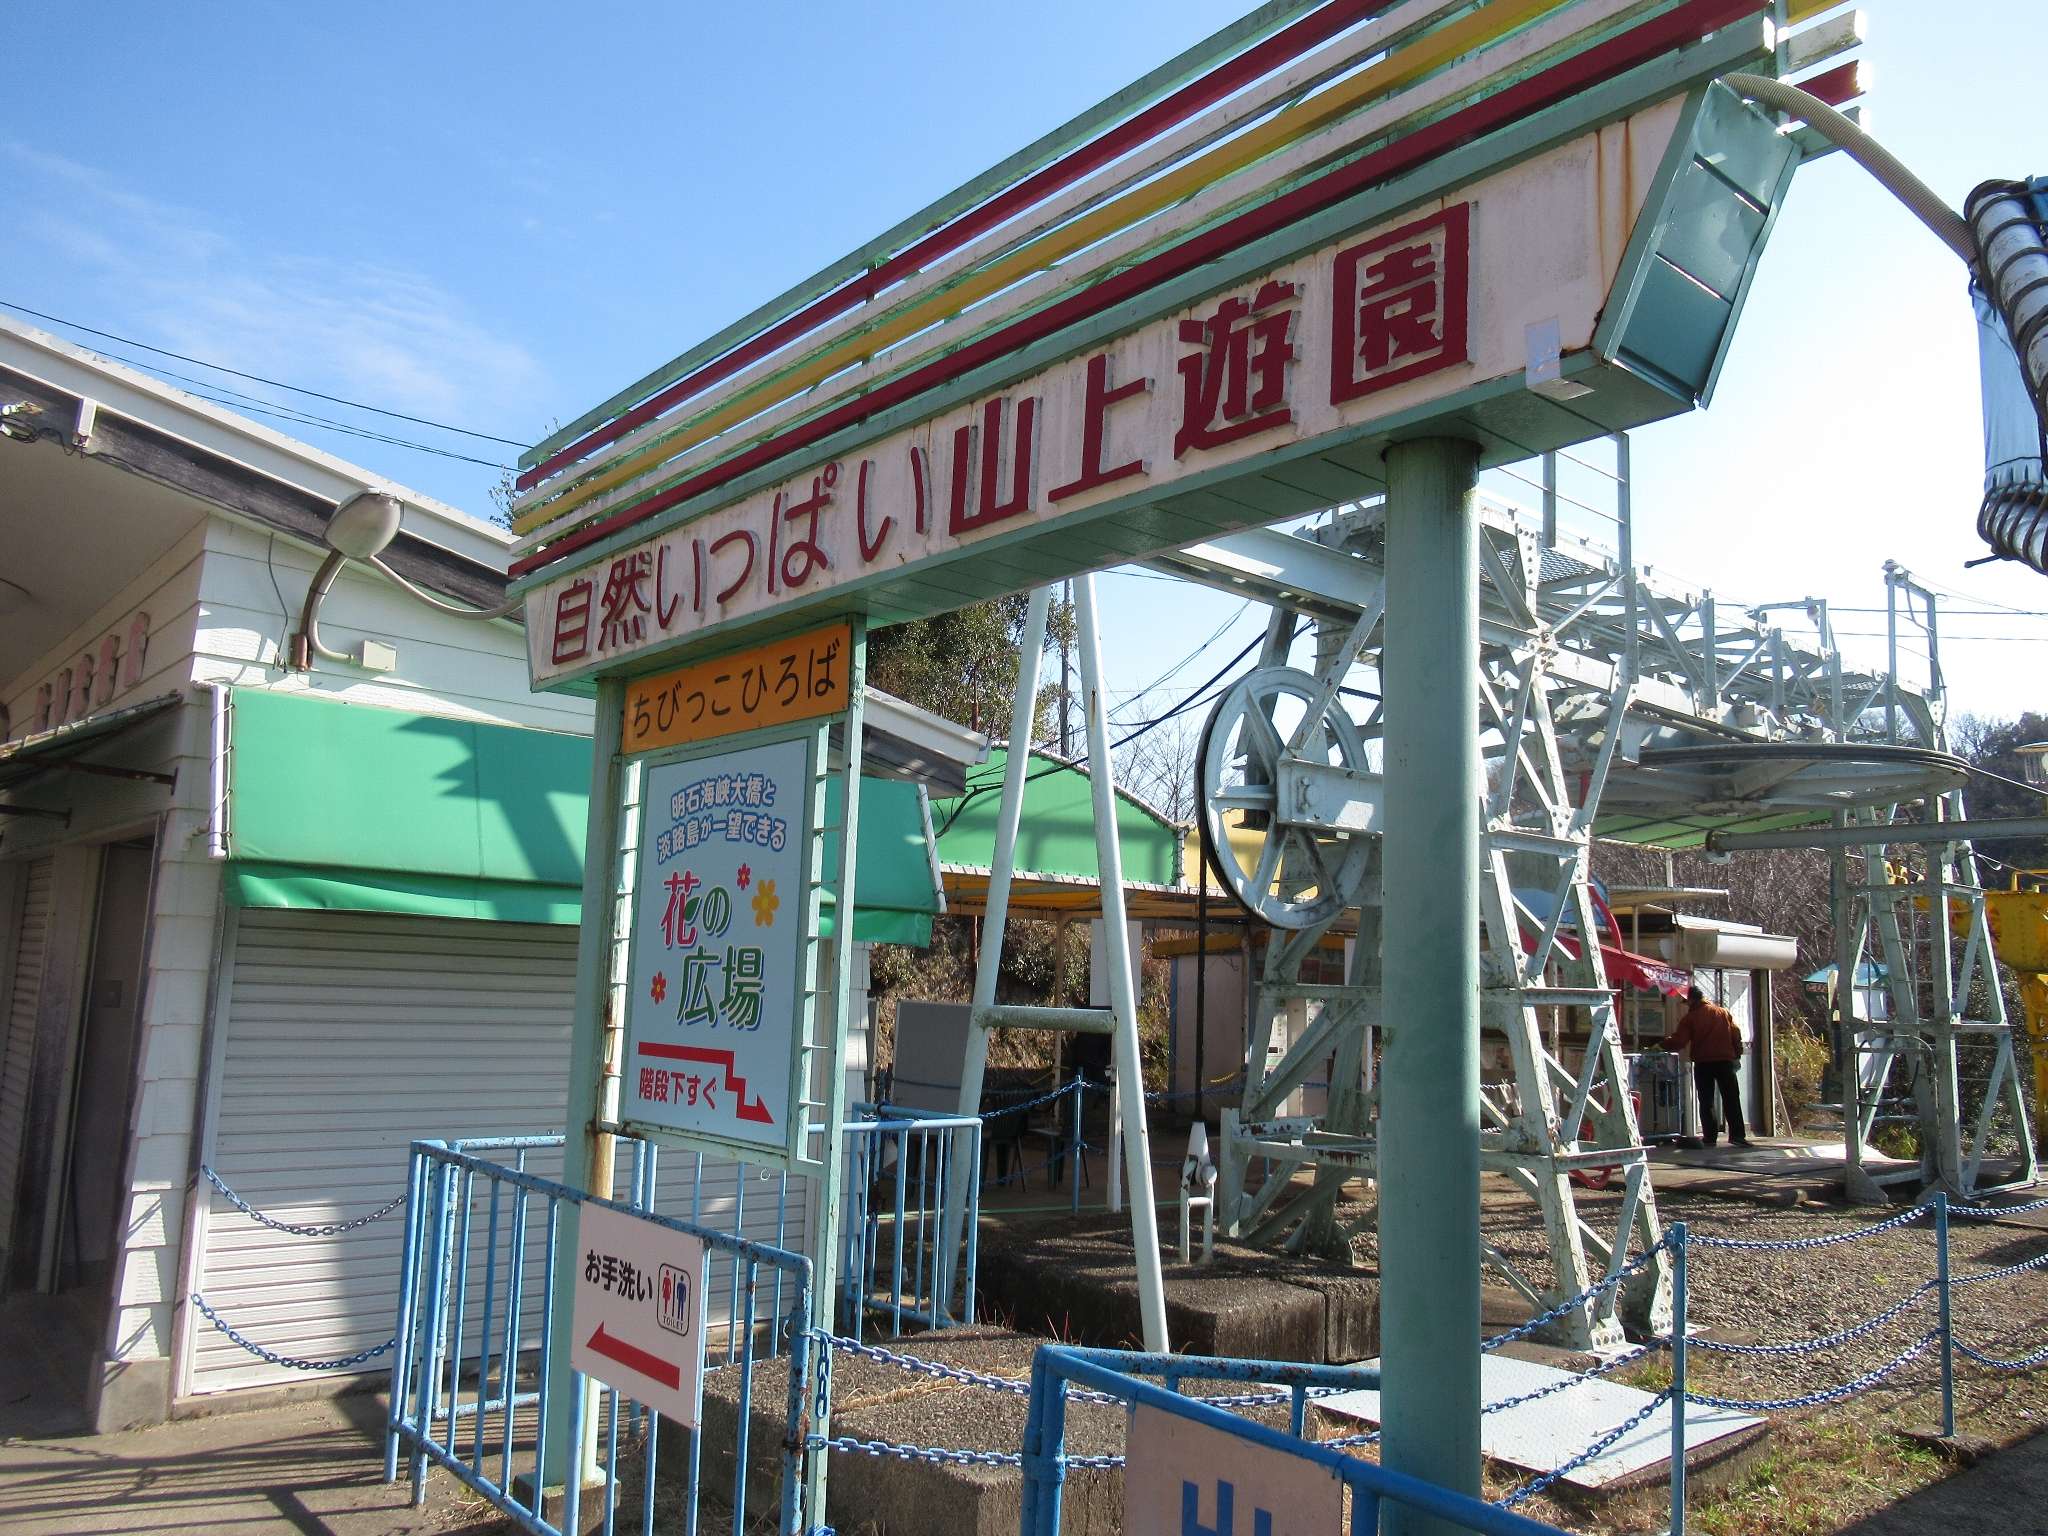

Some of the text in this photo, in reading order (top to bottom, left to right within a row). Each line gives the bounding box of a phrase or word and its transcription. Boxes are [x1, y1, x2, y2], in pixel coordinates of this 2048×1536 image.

[634, 637, 840, 738] ちびっこひろば
[671, 773, 776, 820] 明石海峡大橋と
[657, 811, 786, 864] 淡路島が一望できる
[661, 870, 731, 948] 花の
[677, 945, 765, 1031] 広場
[638, 1067, 717, 1109] 階段下すぐ
[585, 1249, 653, 1301] お手洗い
[663, 1315, 684, 1331] TOILET
